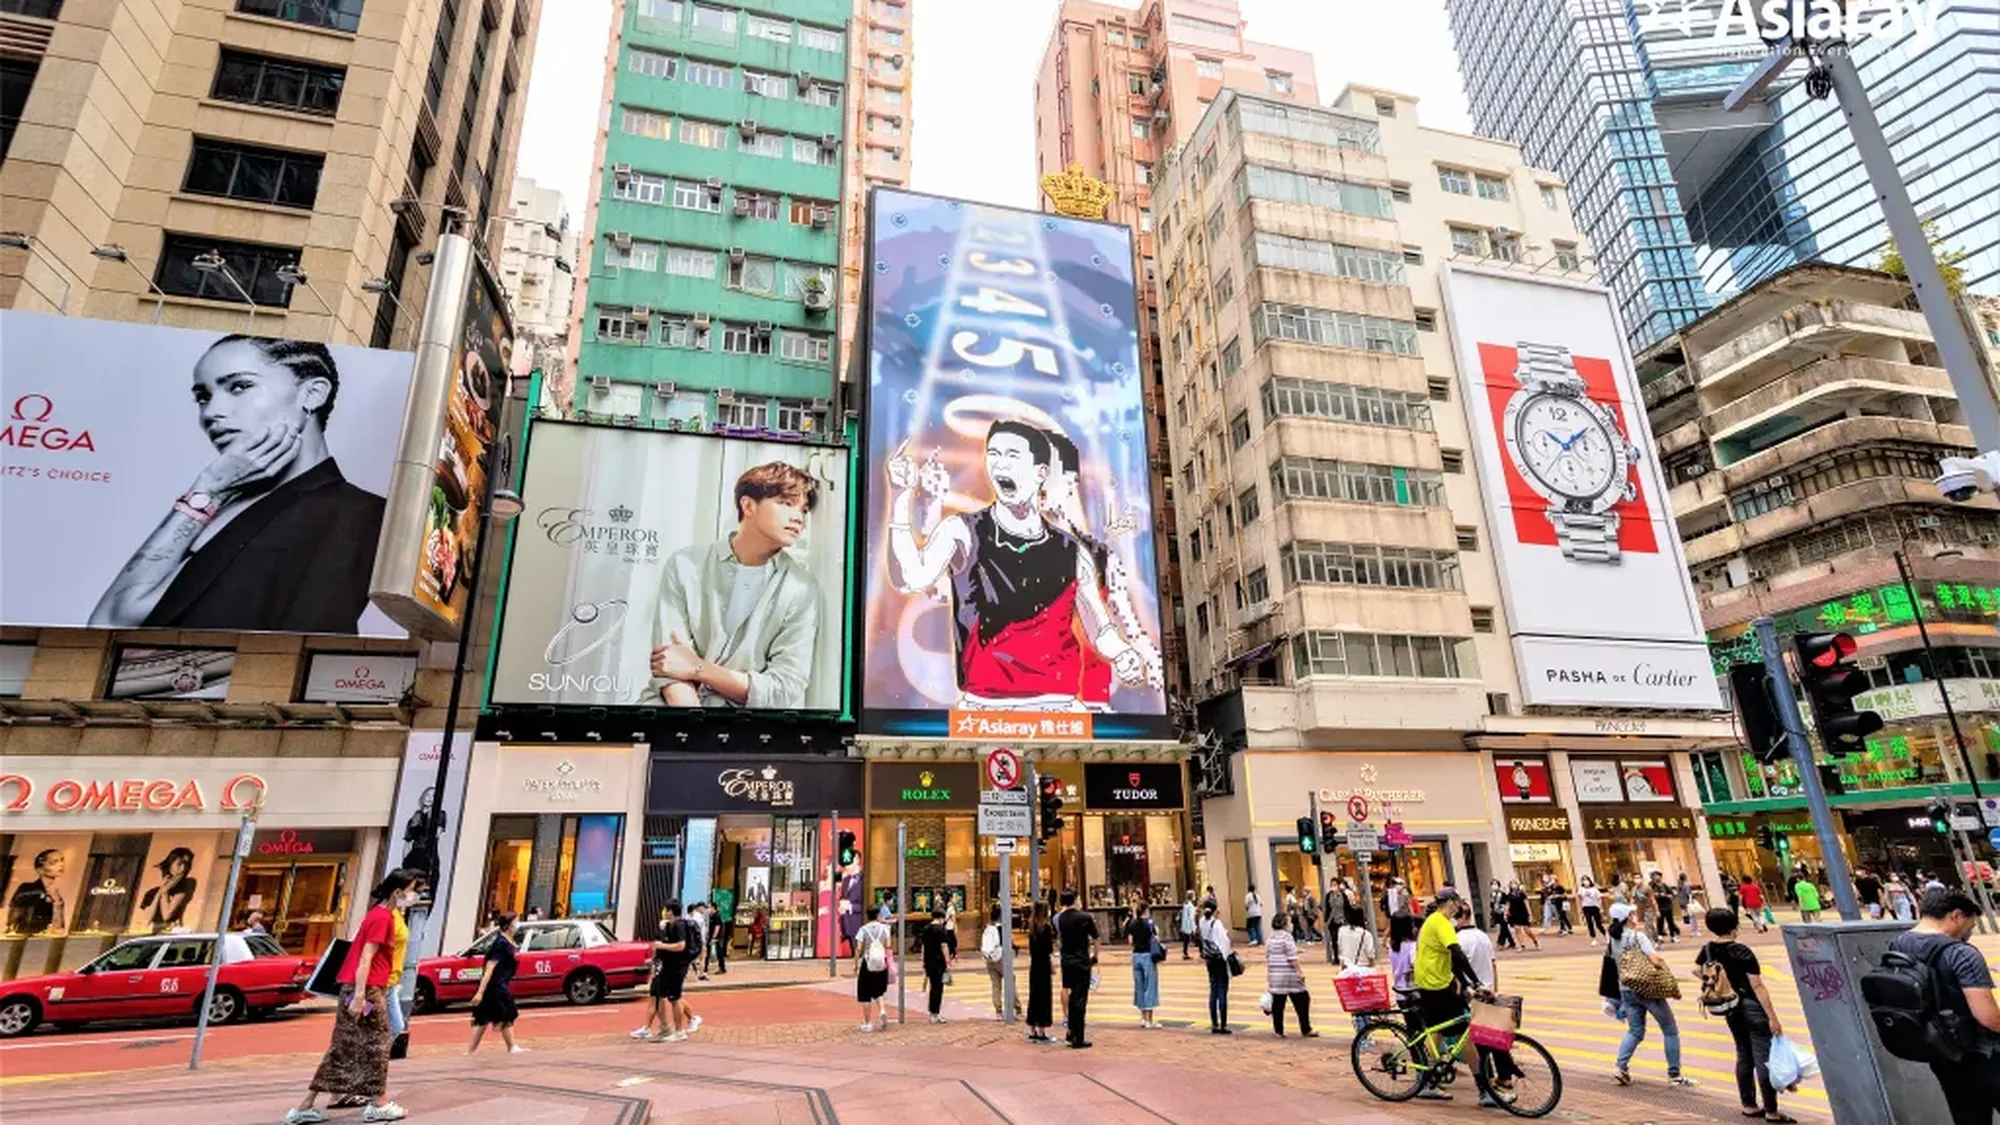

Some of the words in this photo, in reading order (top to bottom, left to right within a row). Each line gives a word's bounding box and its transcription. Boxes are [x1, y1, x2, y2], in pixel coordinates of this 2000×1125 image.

[47, 467, 112, 484] CHOICE
[537, 507, 660, 548] EMPEROR
[1546, 669, 1608, 685] PASHA
[1633, 661, 1698, 687] Cartier
[335, 679, 386, 690] OMEGA
[978, 717, 1038, 738] Asiaray
[718, 768, 794, 797] EMPEROR
[46, 779, 206, 812] OMEGA
[902, 789, 951, 800] ROLEX
[1112, 789, 1158, 800] TUDOR
[259, 842, 314, 854] OMEGA
